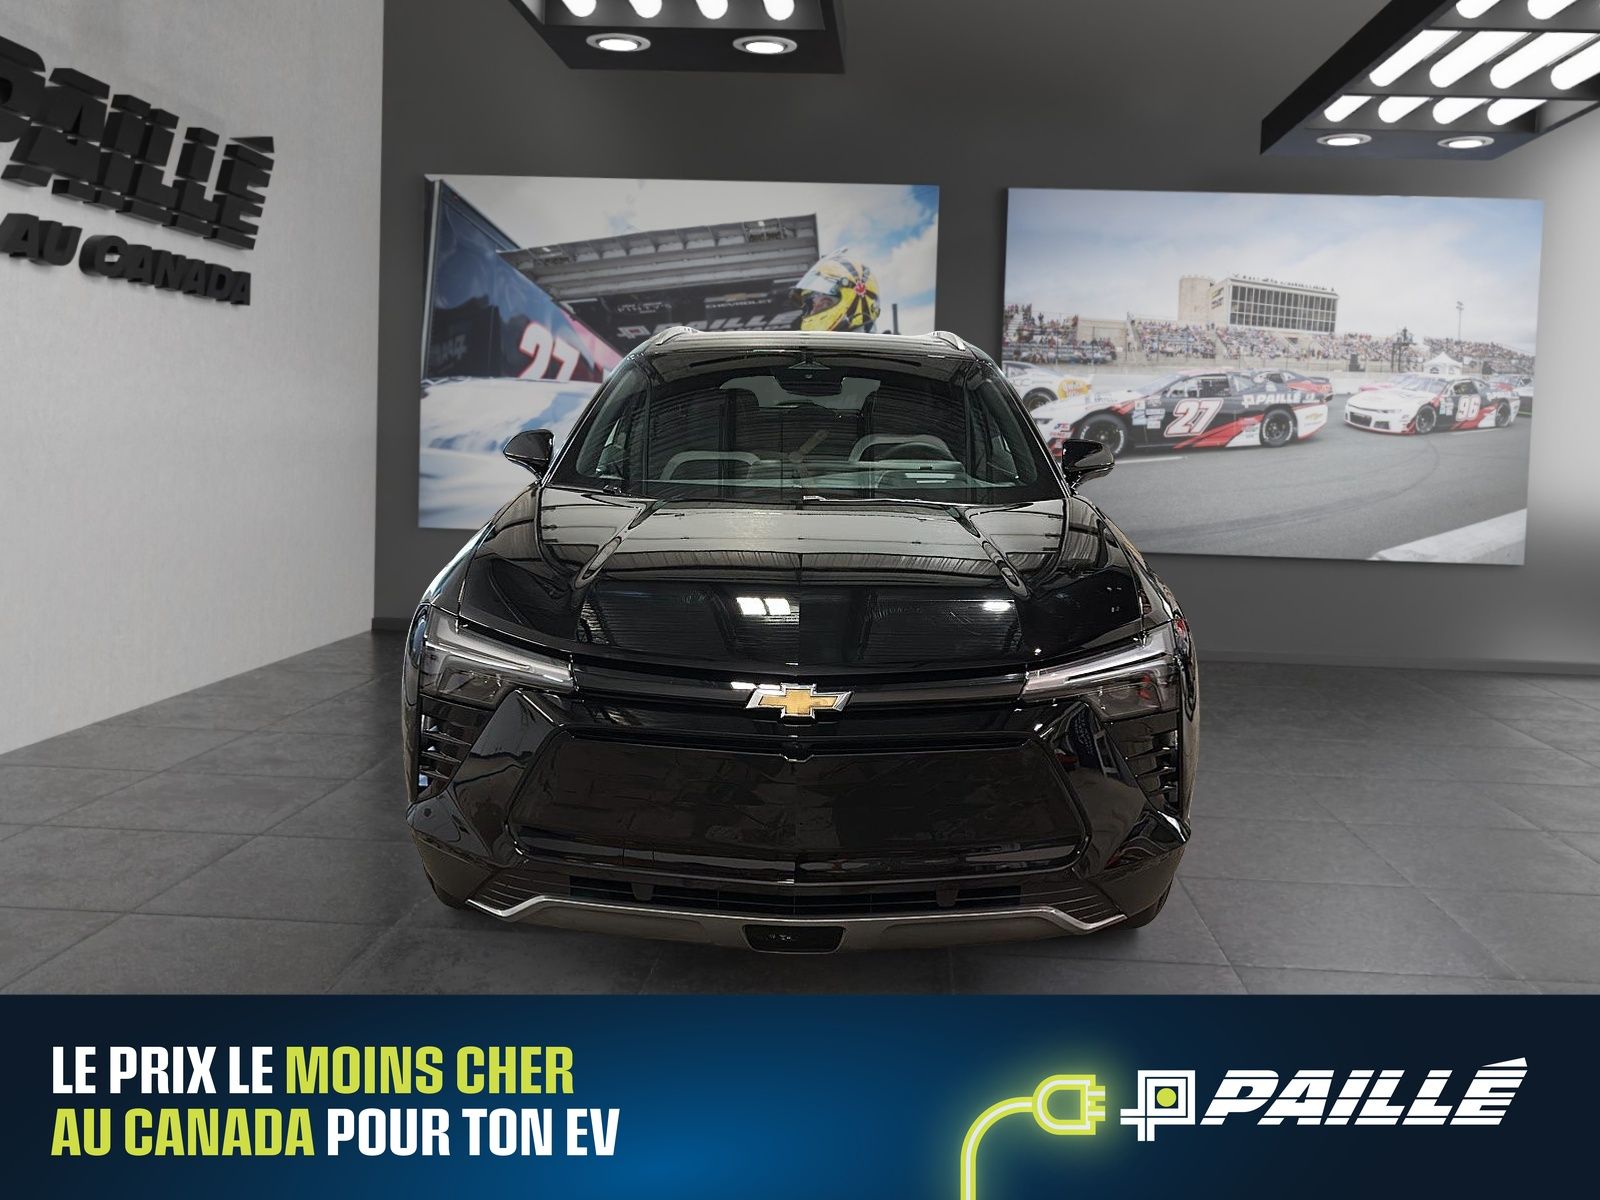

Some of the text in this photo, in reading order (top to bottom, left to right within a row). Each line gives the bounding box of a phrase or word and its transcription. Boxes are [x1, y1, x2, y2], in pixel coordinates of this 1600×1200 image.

[0, 213, 251, 306] AU CANADA
[519, 321, 580, 381] 27
[1164, 397, 1224, 437] 27
